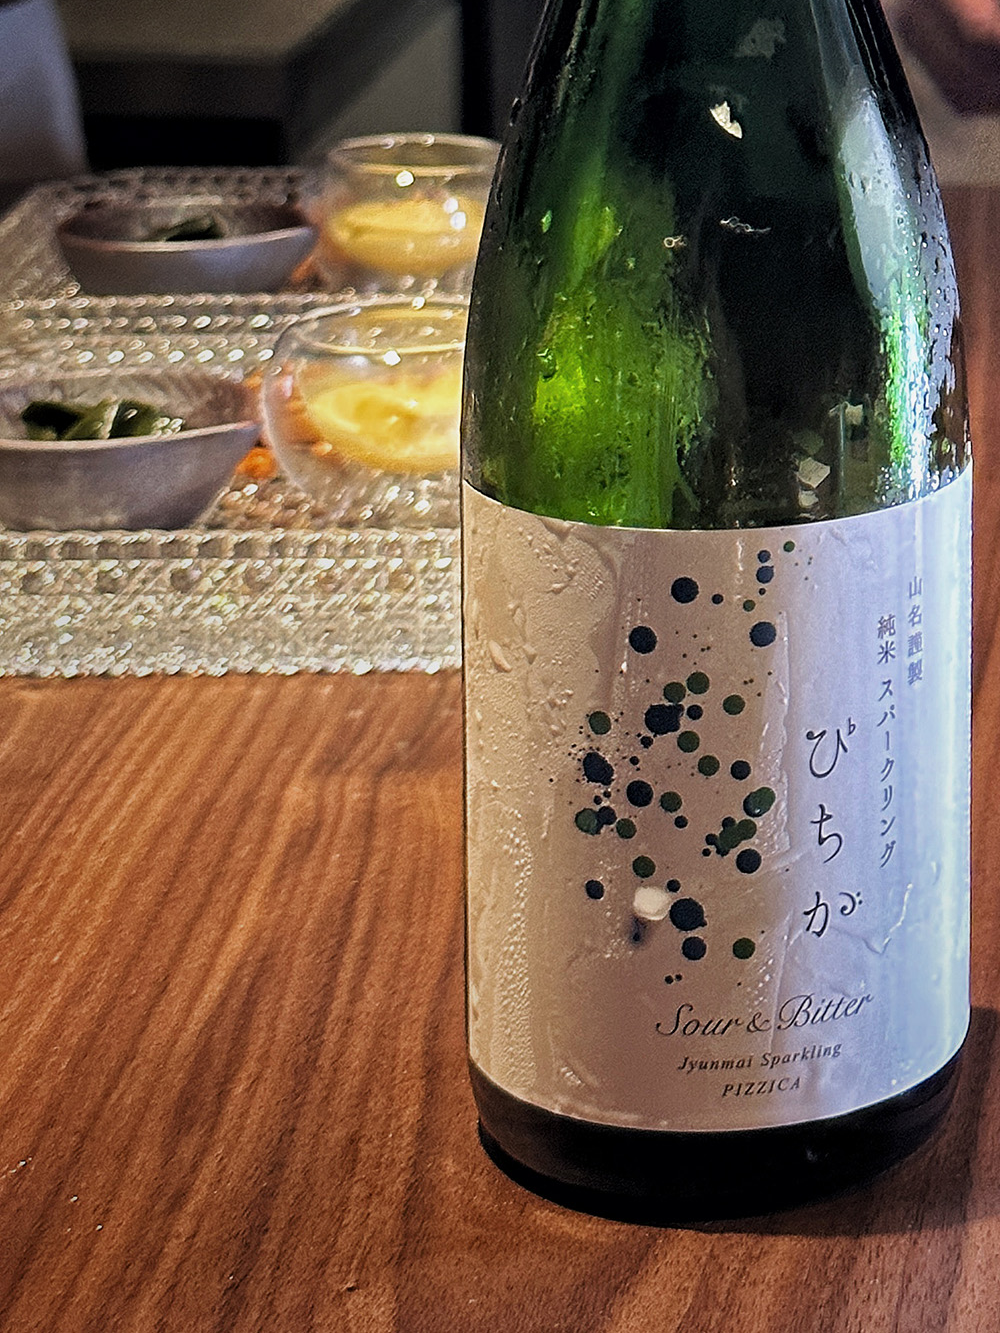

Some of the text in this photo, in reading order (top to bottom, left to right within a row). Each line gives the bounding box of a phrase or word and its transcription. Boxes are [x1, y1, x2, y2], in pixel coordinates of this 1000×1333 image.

[876, 613, 897, 868] 純米 スパークリング
[655, 993, 875, 1037] Sour & Bitter
[677, 1043, 843, 1074] Jyunmai Sparkling
[721, 1076, 802, 1098] PIZZICA
